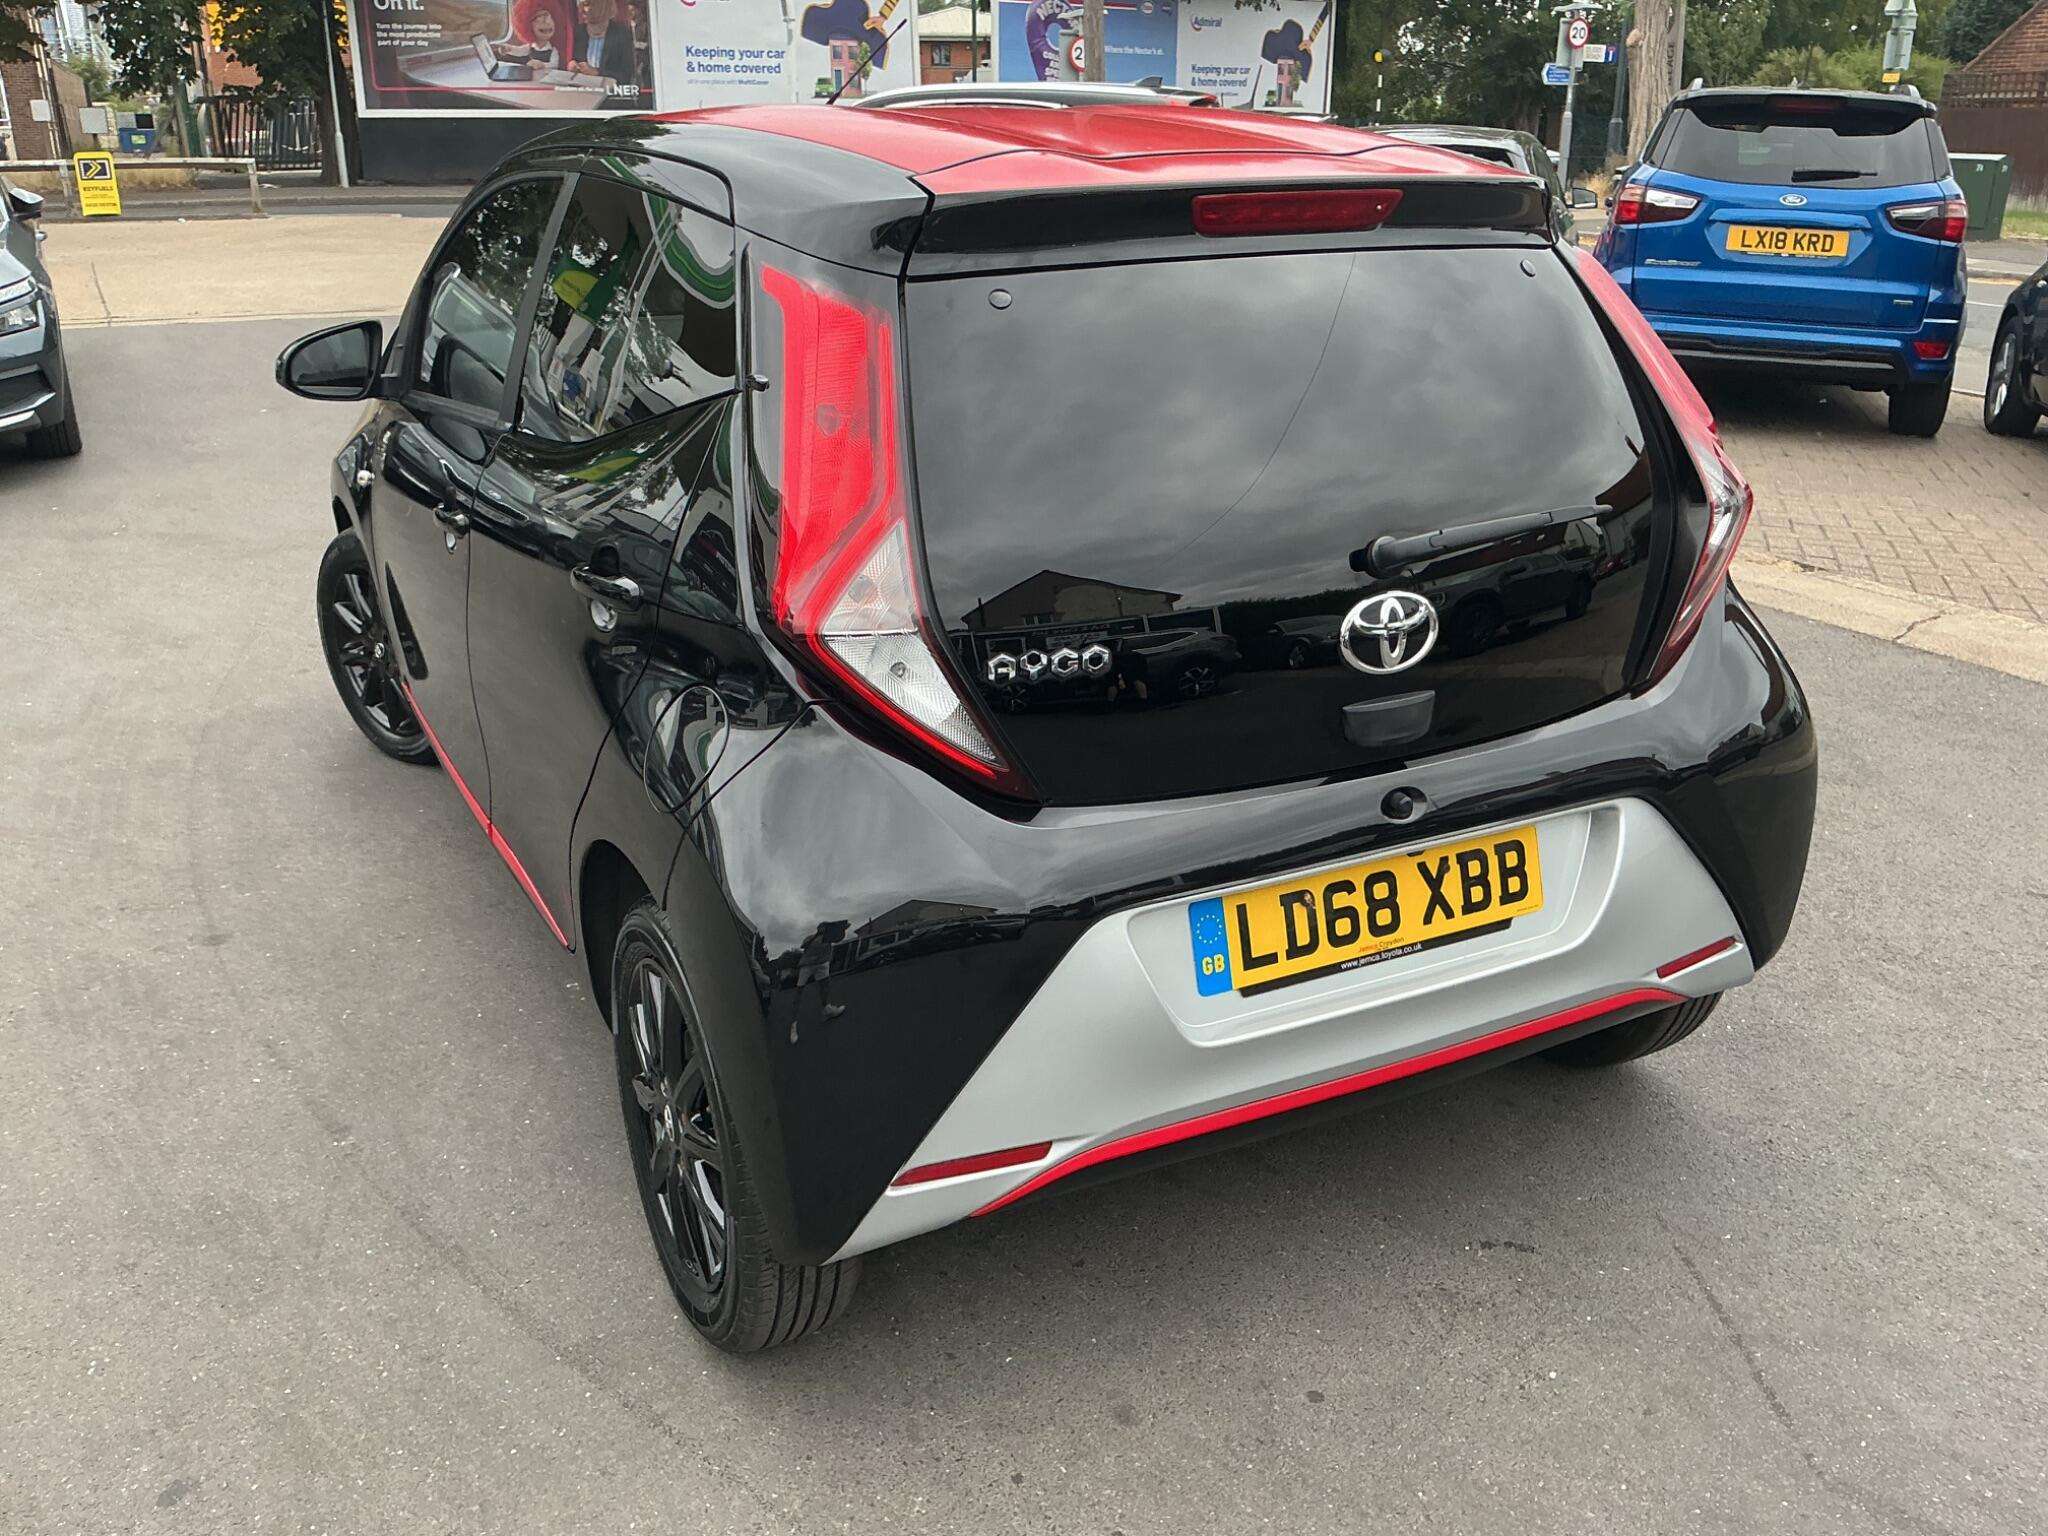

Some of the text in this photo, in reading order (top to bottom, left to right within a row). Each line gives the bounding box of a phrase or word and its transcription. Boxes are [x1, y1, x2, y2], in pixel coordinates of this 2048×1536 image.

[1572, 27, 1586, 39] 20
[685, 45, 786, 60] Keeping your car
[686, 61, 782, 74] & home covered
[1191, 64, 1251, 76] Keeping your car
[1198, 77, 1217, 87] home
[1219, 78, 1247, 87] covered
[605, 84, 640, 96] LNER
[1741, 230, 1834, 253] LX18 KRD
[987, 645, 1111, 681] AYGO
[1236, 839, 1529, 971] LD68 XBB
[1201, 953, 1226, 976] GB
